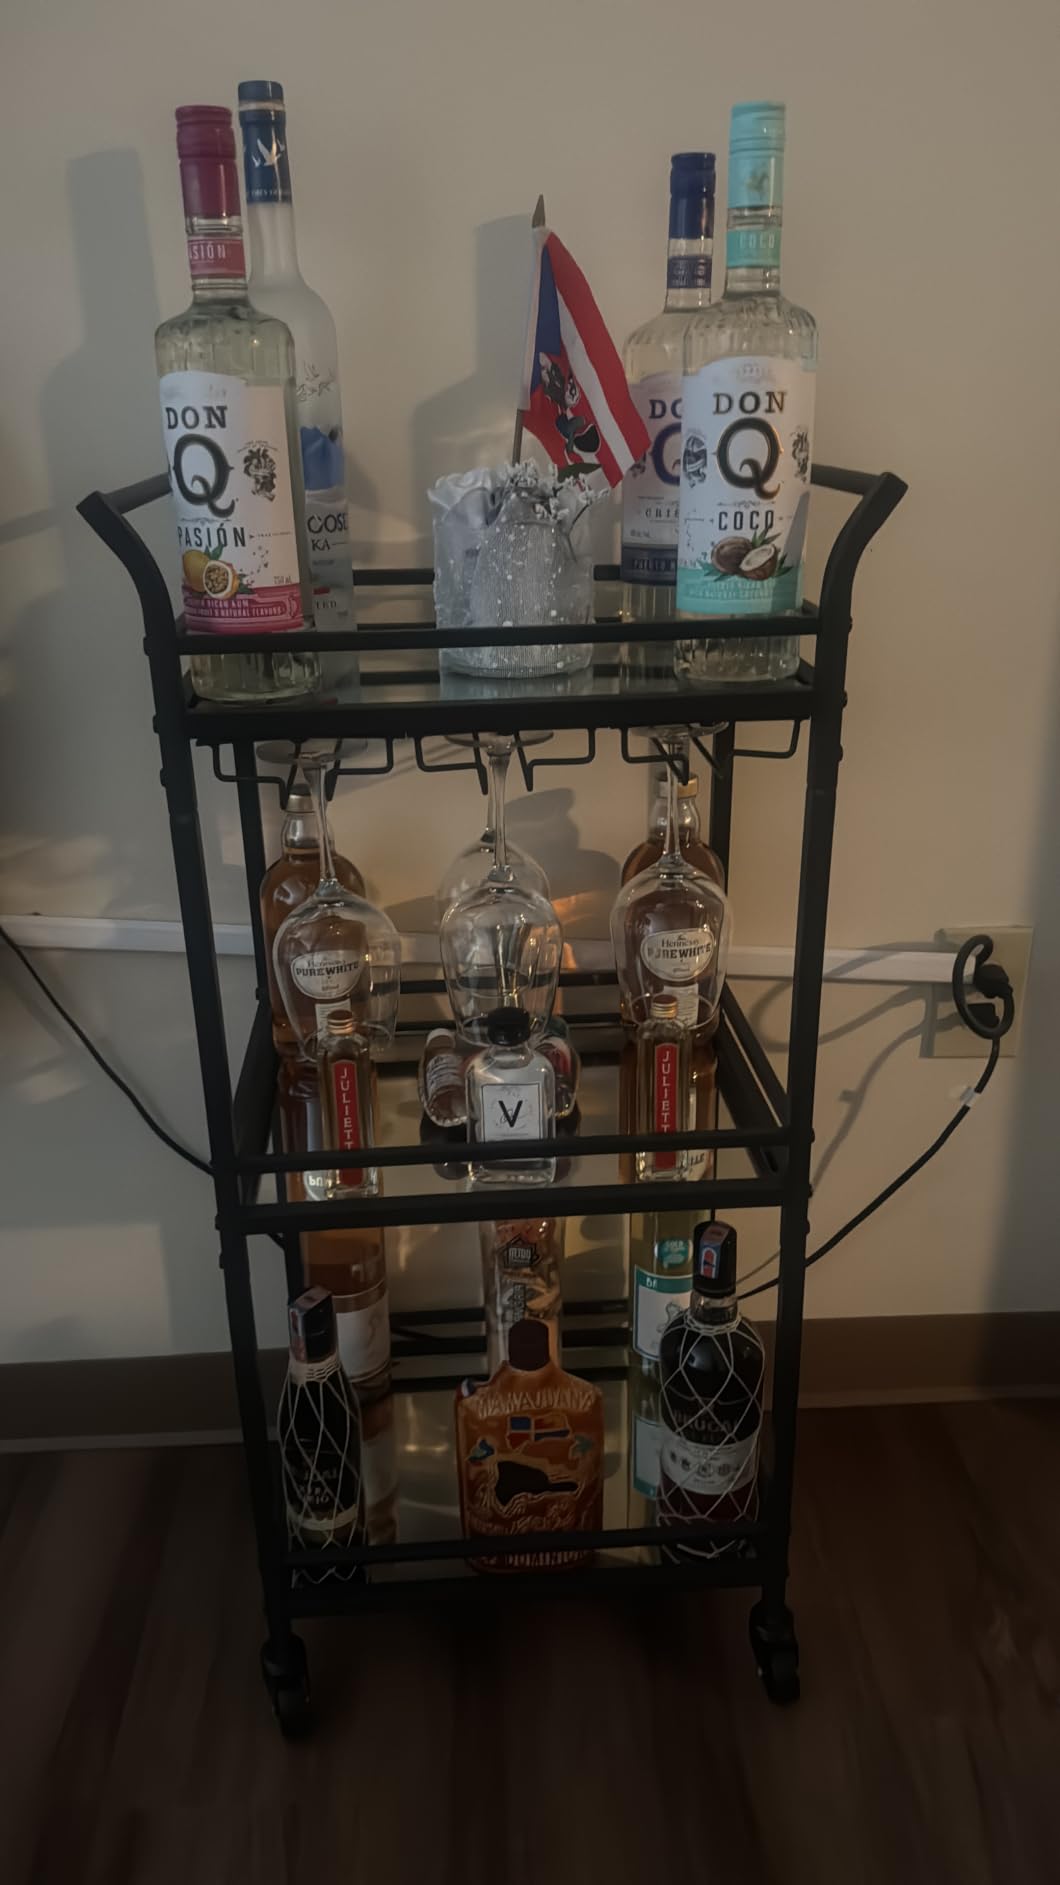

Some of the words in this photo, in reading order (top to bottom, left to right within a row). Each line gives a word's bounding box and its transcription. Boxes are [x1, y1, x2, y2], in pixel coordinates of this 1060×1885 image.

[649, 397, 683, 420] DO
[713, 391, 788, 415] DON
[165, 405, 228, 430] DON
[712, 417, 785, 500] Q
[172, 433, 237, 518] Q
[717, 509, 775, 532] COCO
[177, 523, 246, 549] PASIÓN
[498, 1099, 523, 1128] V
